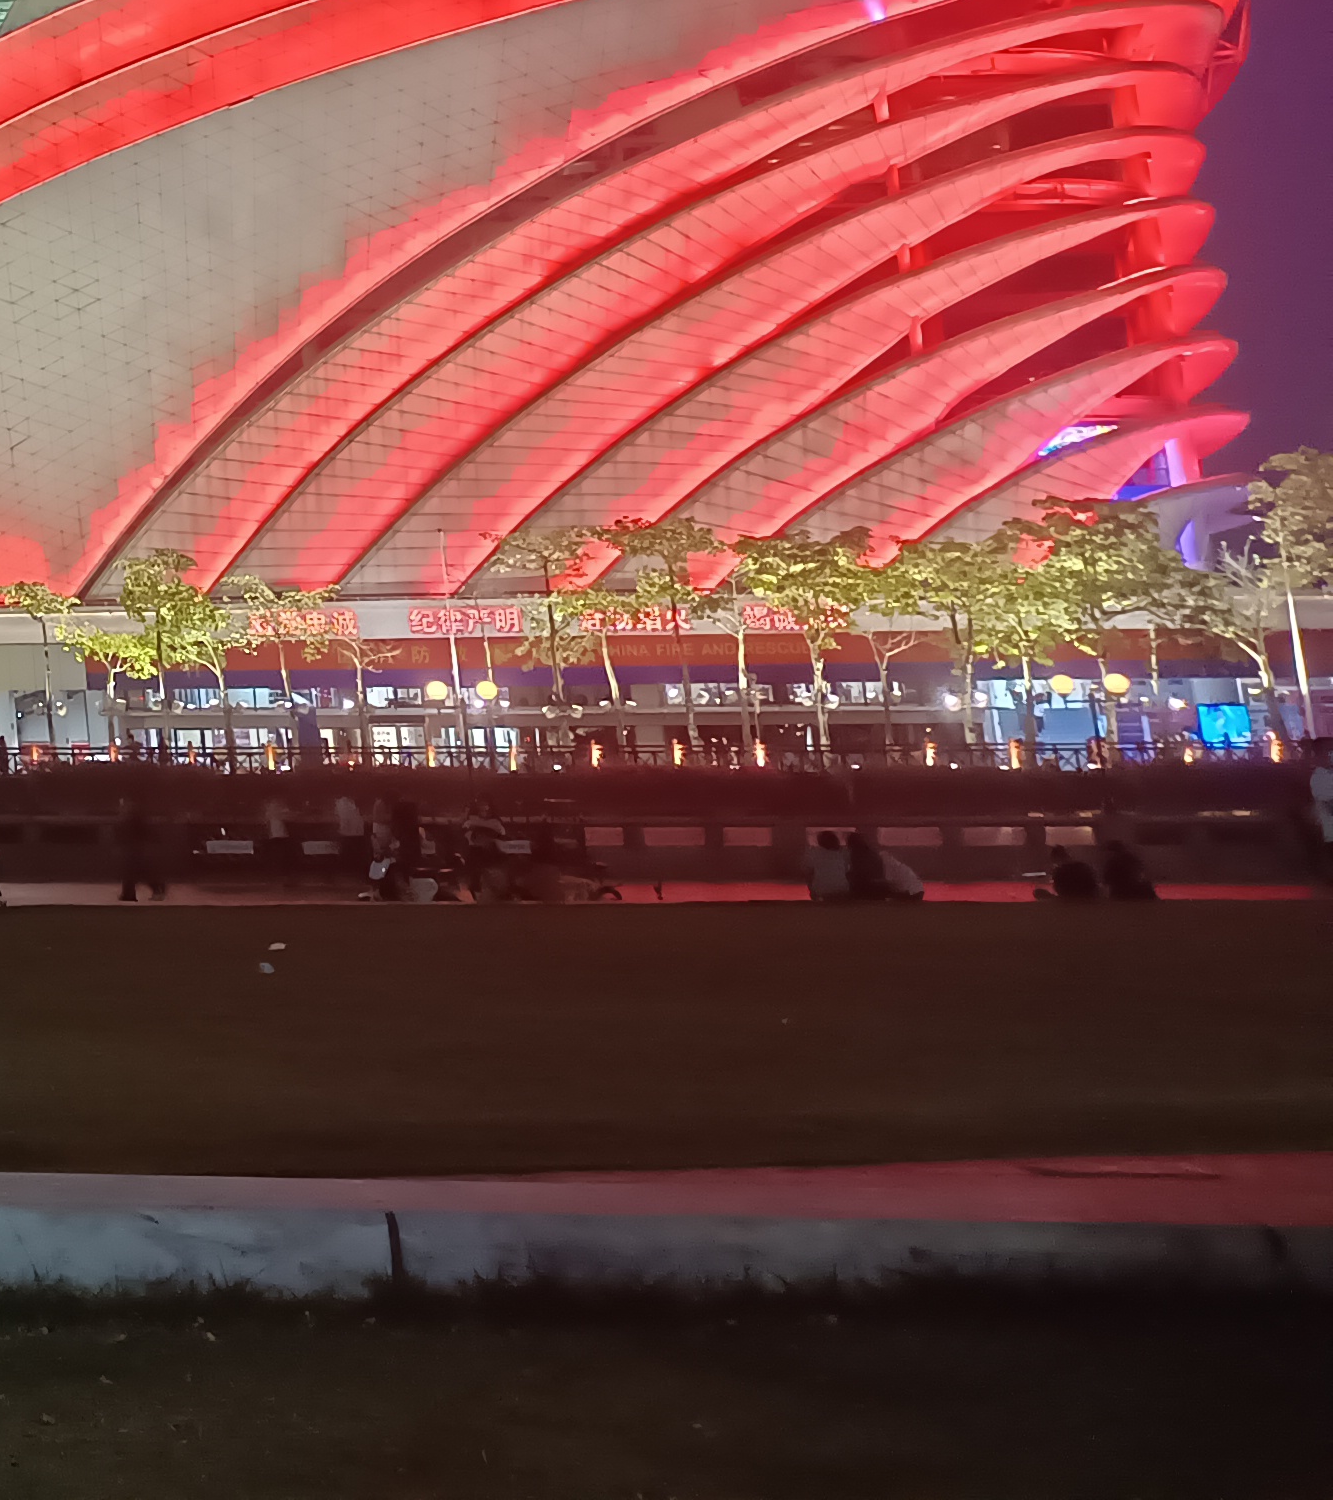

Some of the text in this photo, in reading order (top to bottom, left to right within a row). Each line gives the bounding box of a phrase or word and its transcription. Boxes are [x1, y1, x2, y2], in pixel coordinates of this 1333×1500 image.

[409, 606, 521, 634] 纪律严明
[602, 644, 650, 657] HINA
[656, 643, 693, 656] FIRE
[702, 643, 736, 656] AND
